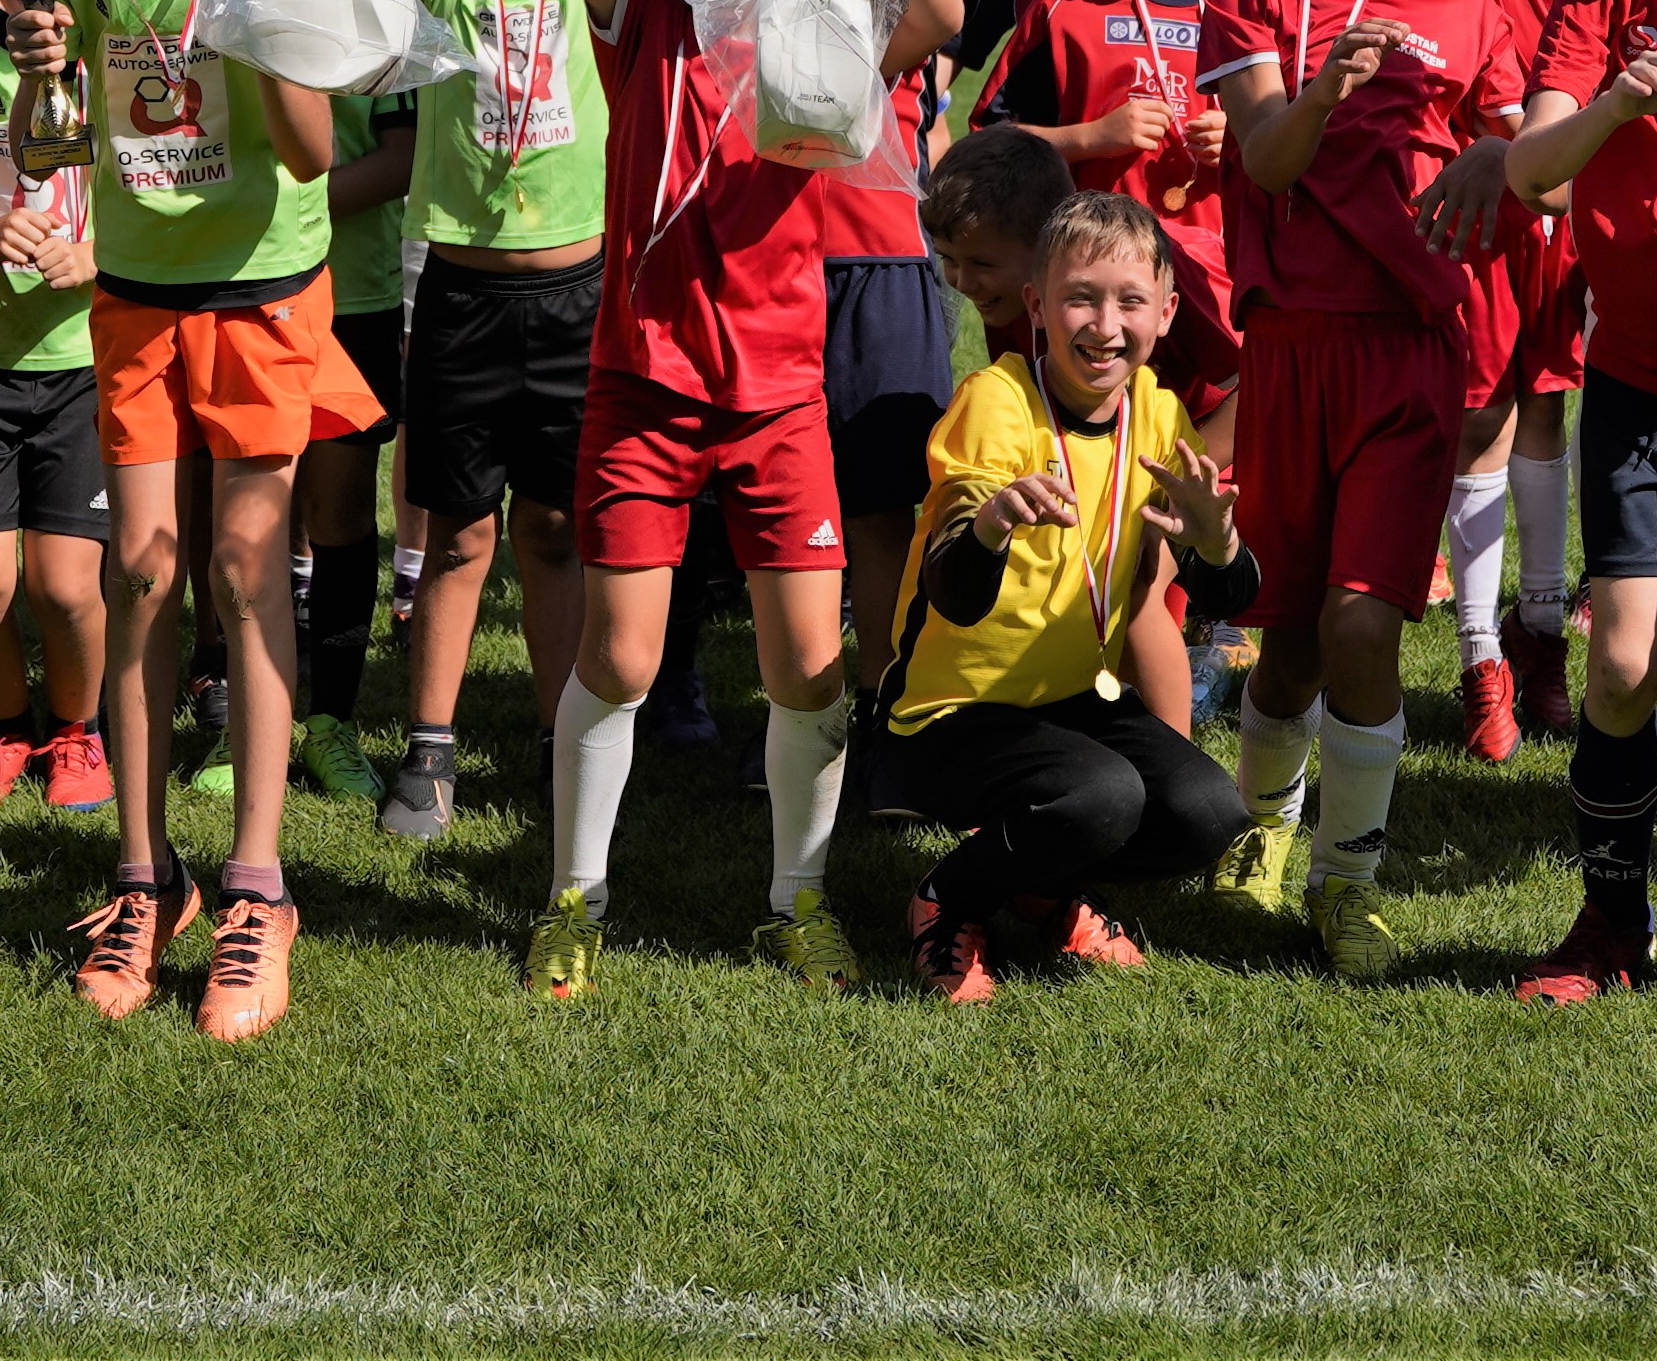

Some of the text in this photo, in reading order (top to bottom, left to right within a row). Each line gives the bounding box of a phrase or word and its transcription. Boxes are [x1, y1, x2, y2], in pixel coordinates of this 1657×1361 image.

[109, 38, 131, 50] GP
[483, 126, 569, 146] PRMIUM
[118, 142, 225, 166] Q-SERVICE
[121, 163, 227, 189] PREMIUM
[807, 537, 839, 546] adidas
[1589, 866, 1643, 881] ARIS
